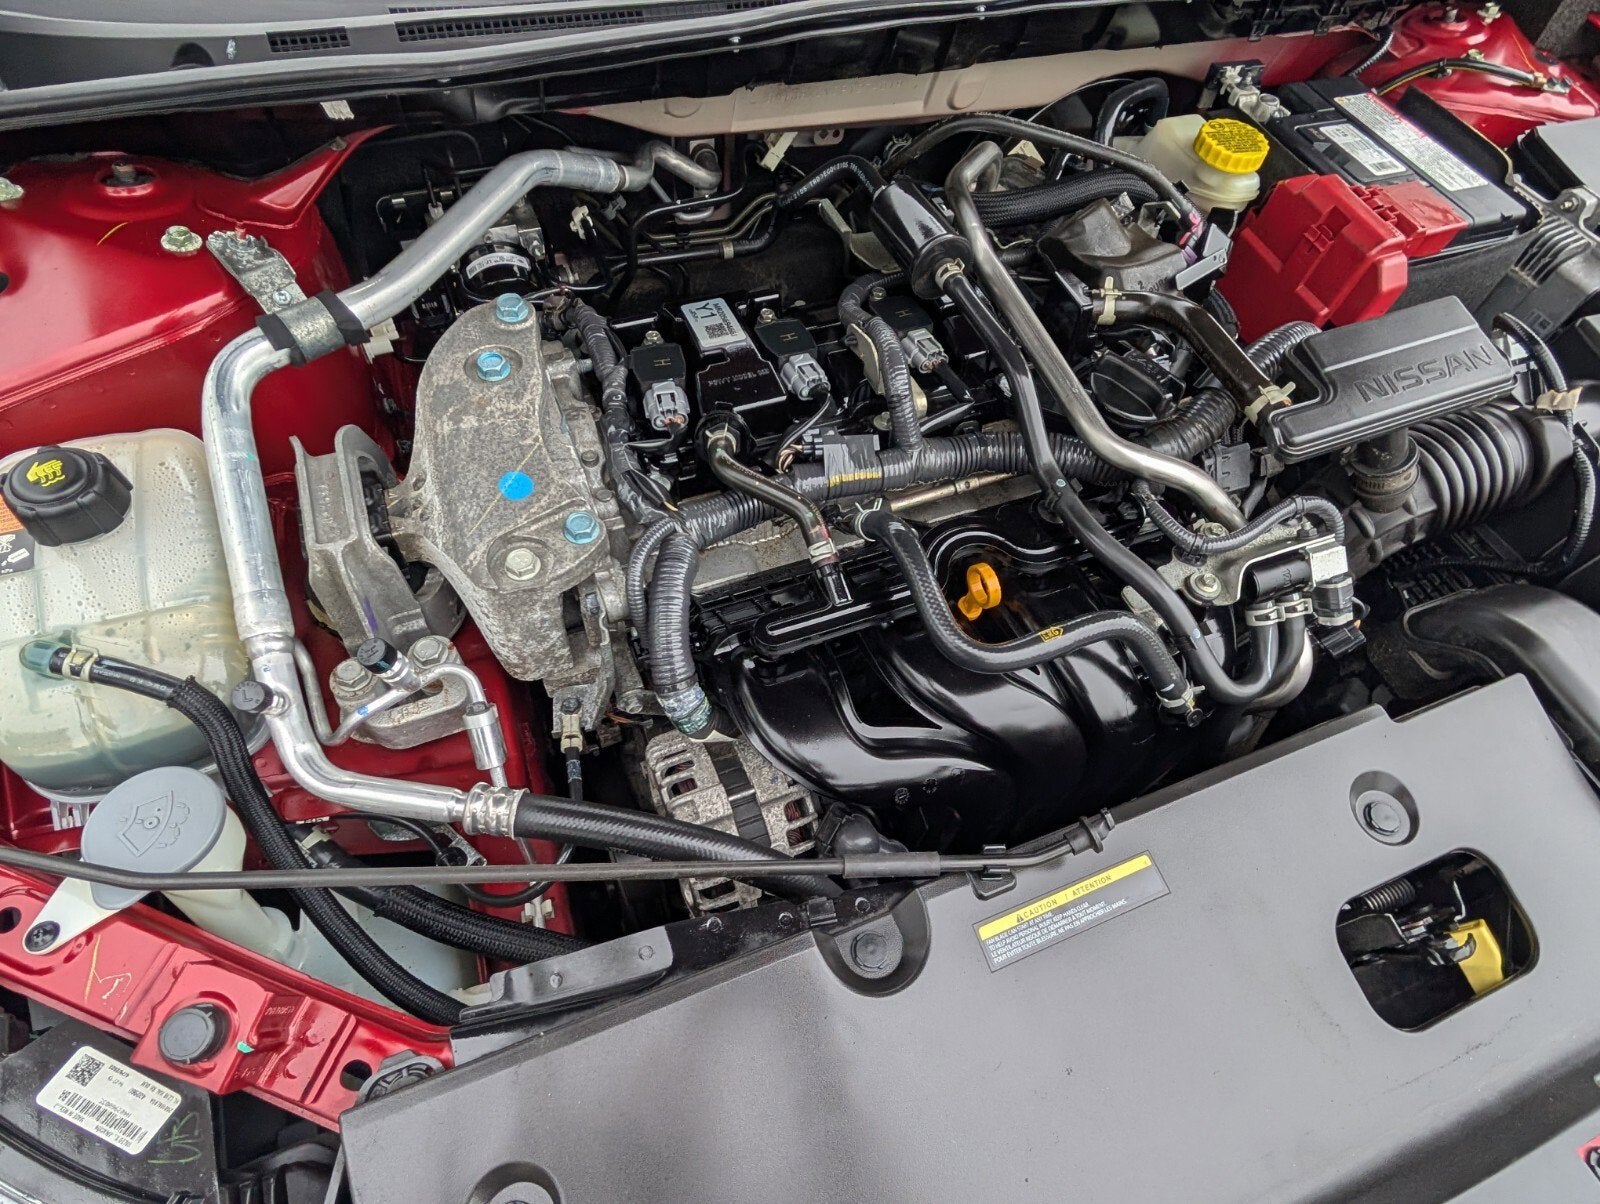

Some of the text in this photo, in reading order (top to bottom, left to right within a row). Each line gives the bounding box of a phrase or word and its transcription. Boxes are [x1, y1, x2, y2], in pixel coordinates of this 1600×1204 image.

[695, 302, 717, 319] Y1
[1353, 344, 1494, 403] NISSAN
[1022, 898, 1058, 918] CAUTION
[1071, 874, 1112, 896] ATTENTION
